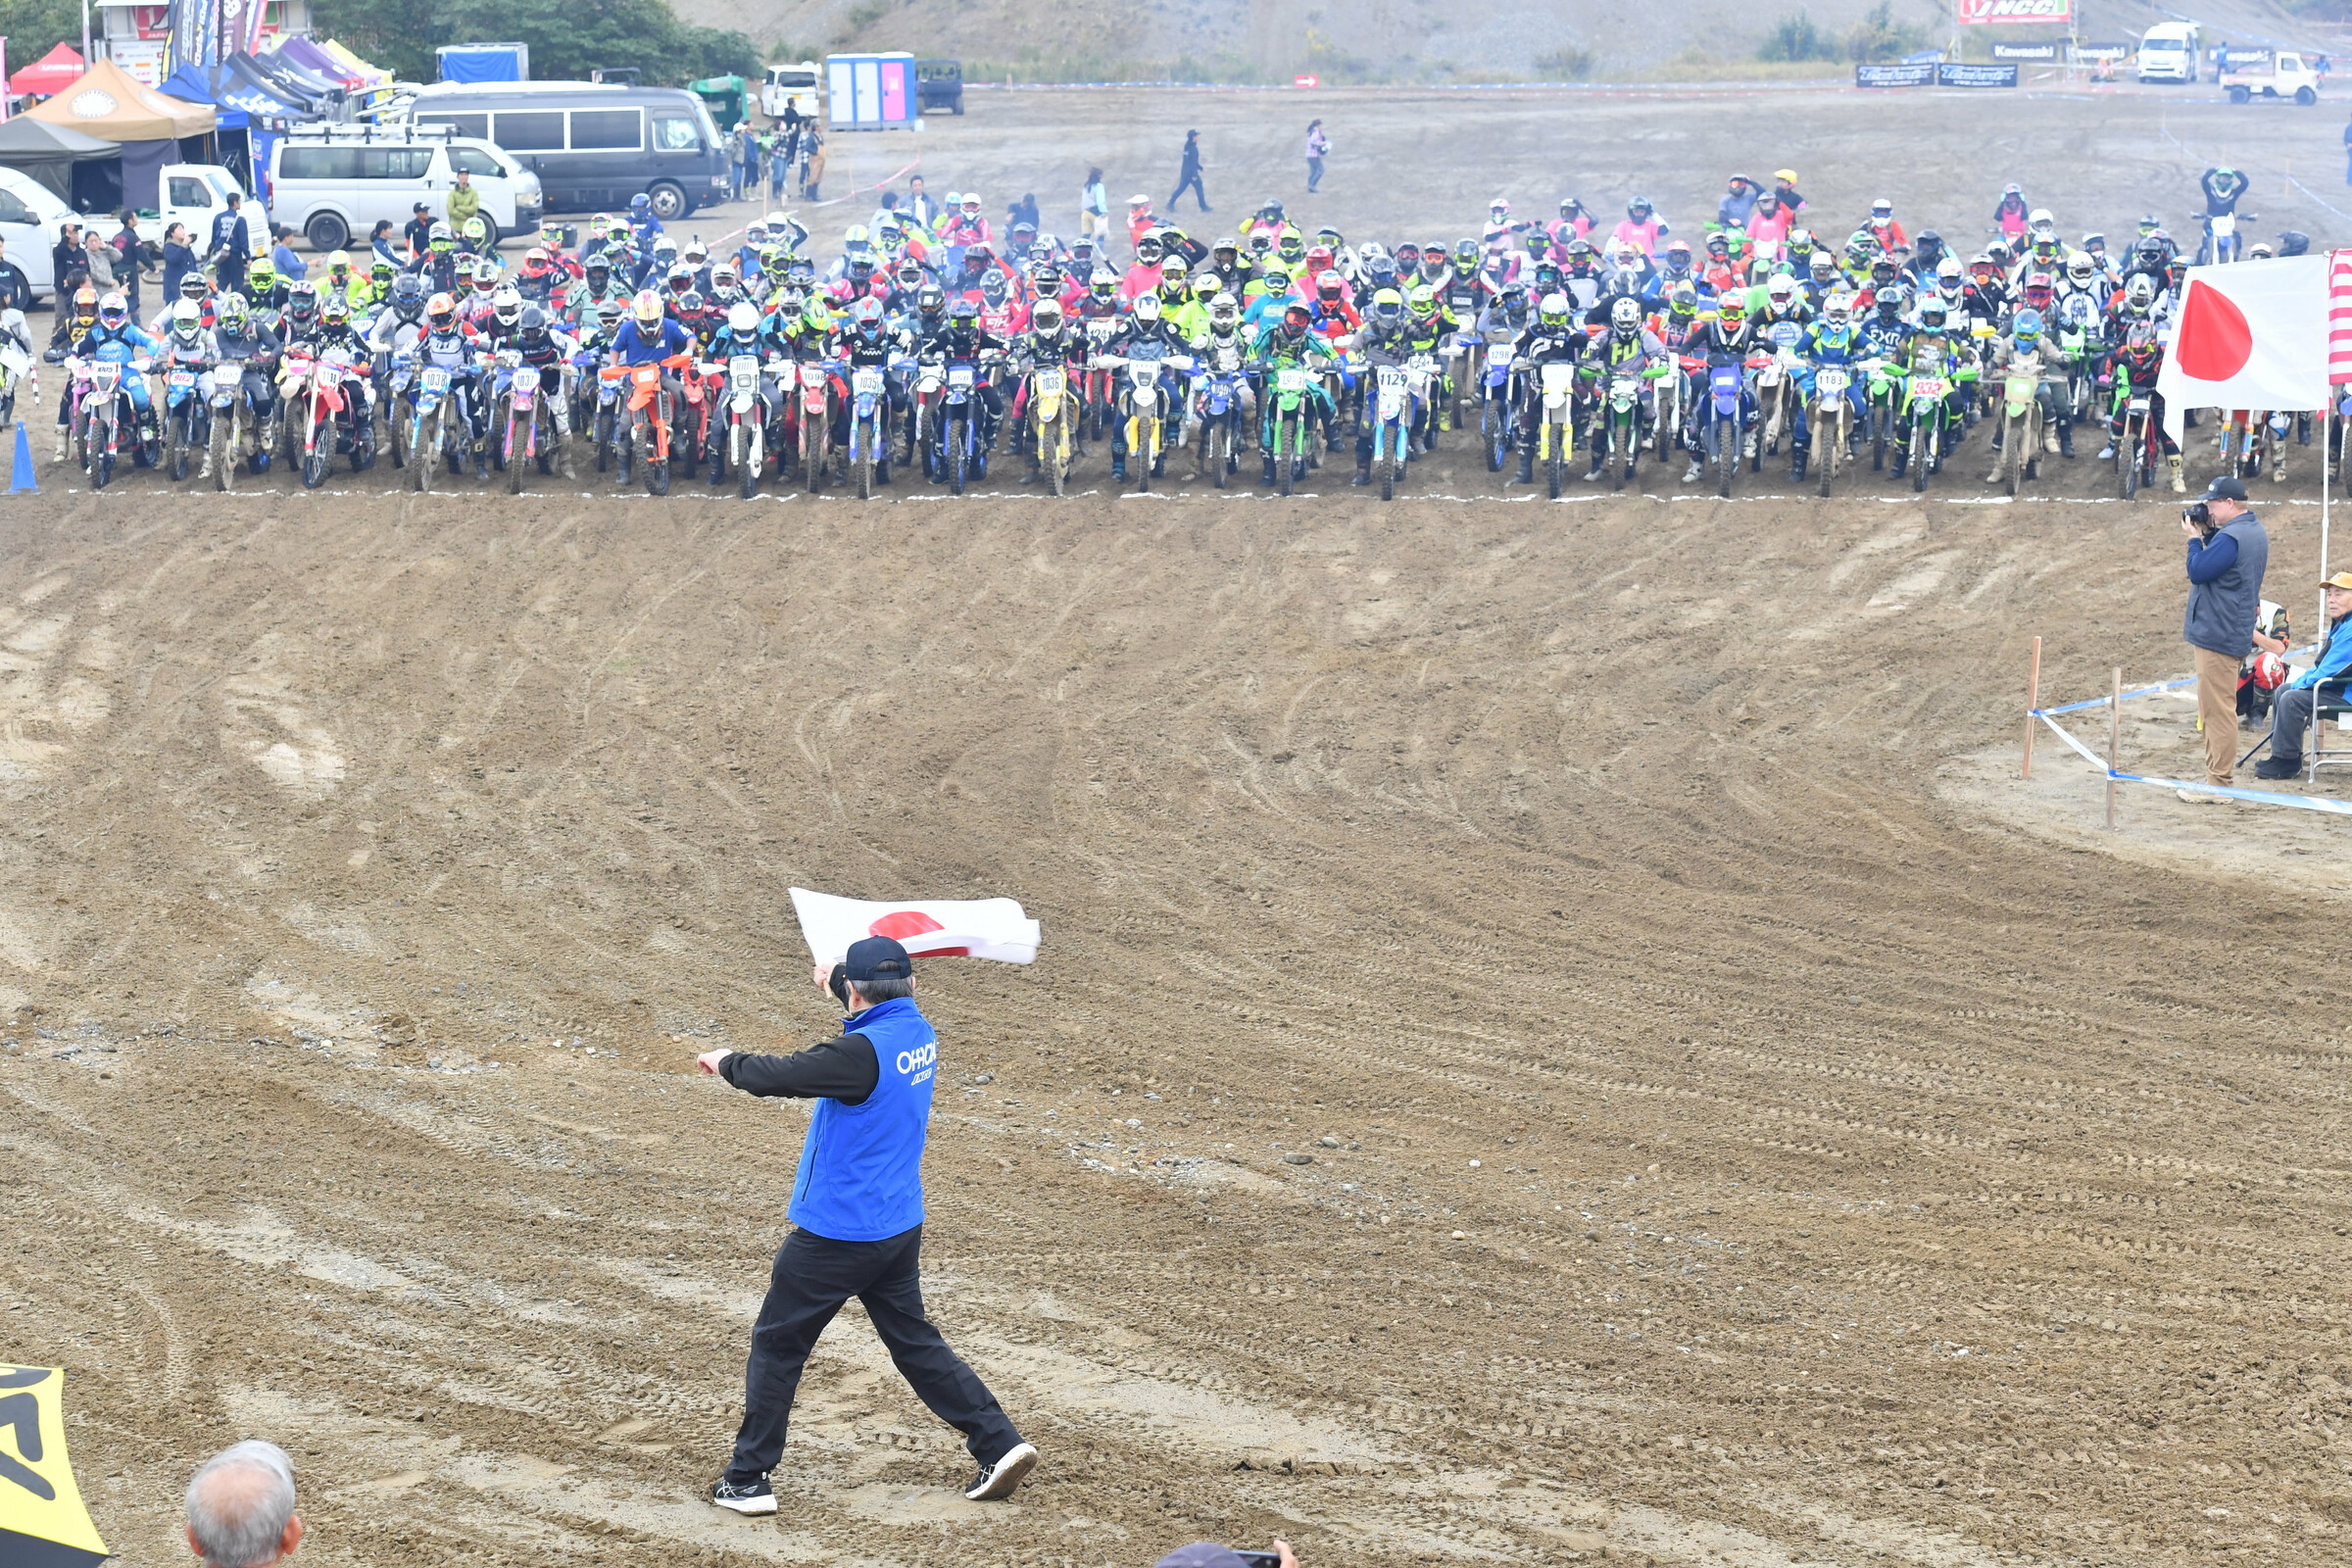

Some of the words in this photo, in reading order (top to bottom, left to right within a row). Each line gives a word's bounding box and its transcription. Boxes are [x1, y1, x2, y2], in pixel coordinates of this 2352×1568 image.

[1994, 45, 2053, 58] Kawasaki
[2209, 49, 2269, 62] Kwasaki
[1870, 328, 1901, 346] FXR
[426, 373, 447, 386] 1038
[517, 374, 535, 387] 1037
[805, 372, 826, 381] 1098
[859, 376, 878, 389] 1035
[1042, 376, 1059, 390] 1036
[1381, 373, 1407, 386] 1129
[1820, 375, 1842, 385] 1183
[1914, 381, 1943, 396] 932
